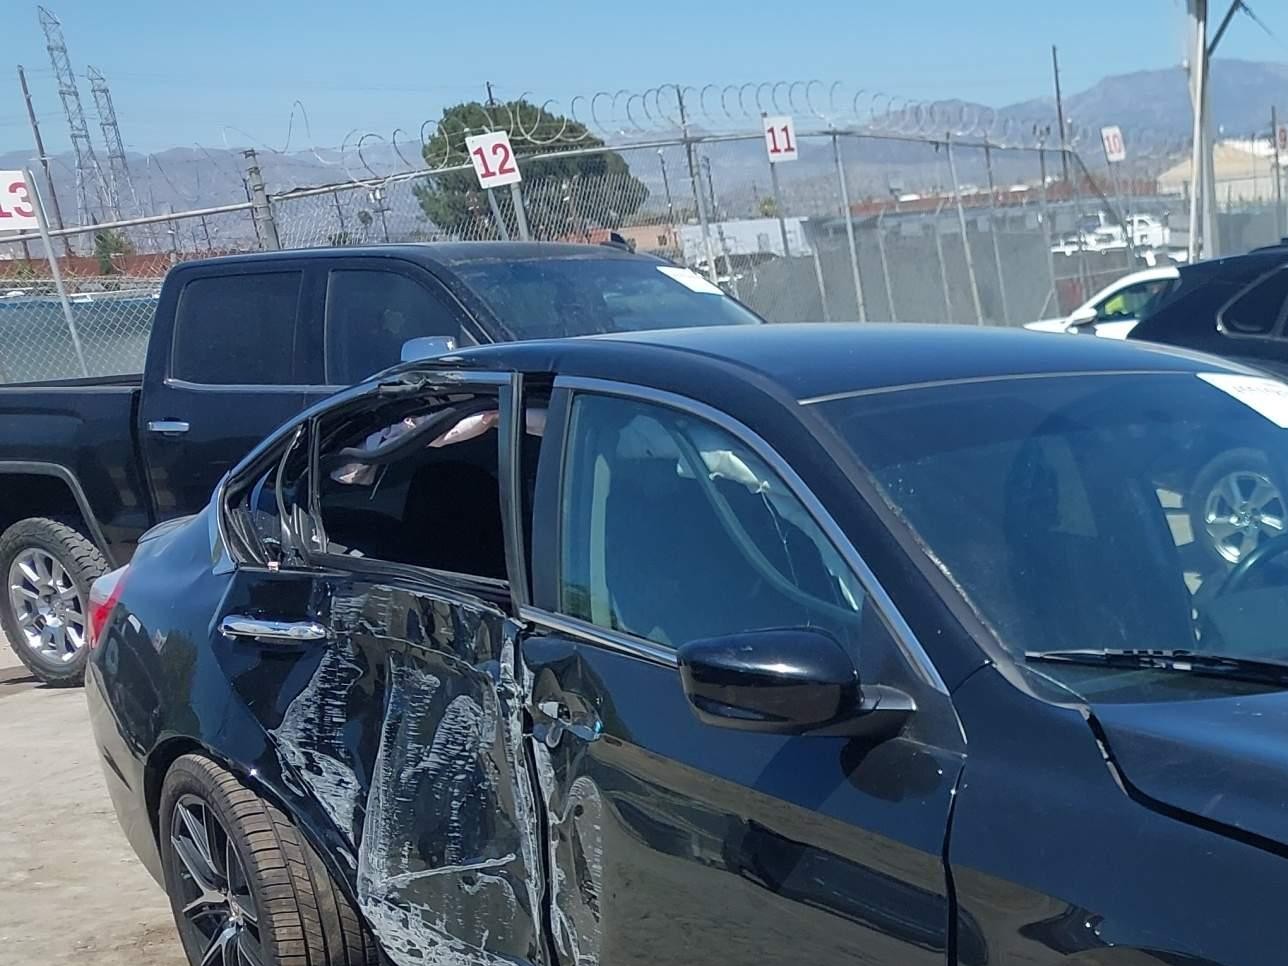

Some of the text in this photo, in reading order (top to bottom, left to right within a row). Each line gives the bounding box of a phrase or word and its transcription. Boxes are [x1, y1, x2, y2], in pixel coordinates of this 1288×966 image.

[767, 125, 795, 153] 11
[1104, 134, 1122, 154] 10
[473, 143, 516, 178] 12
